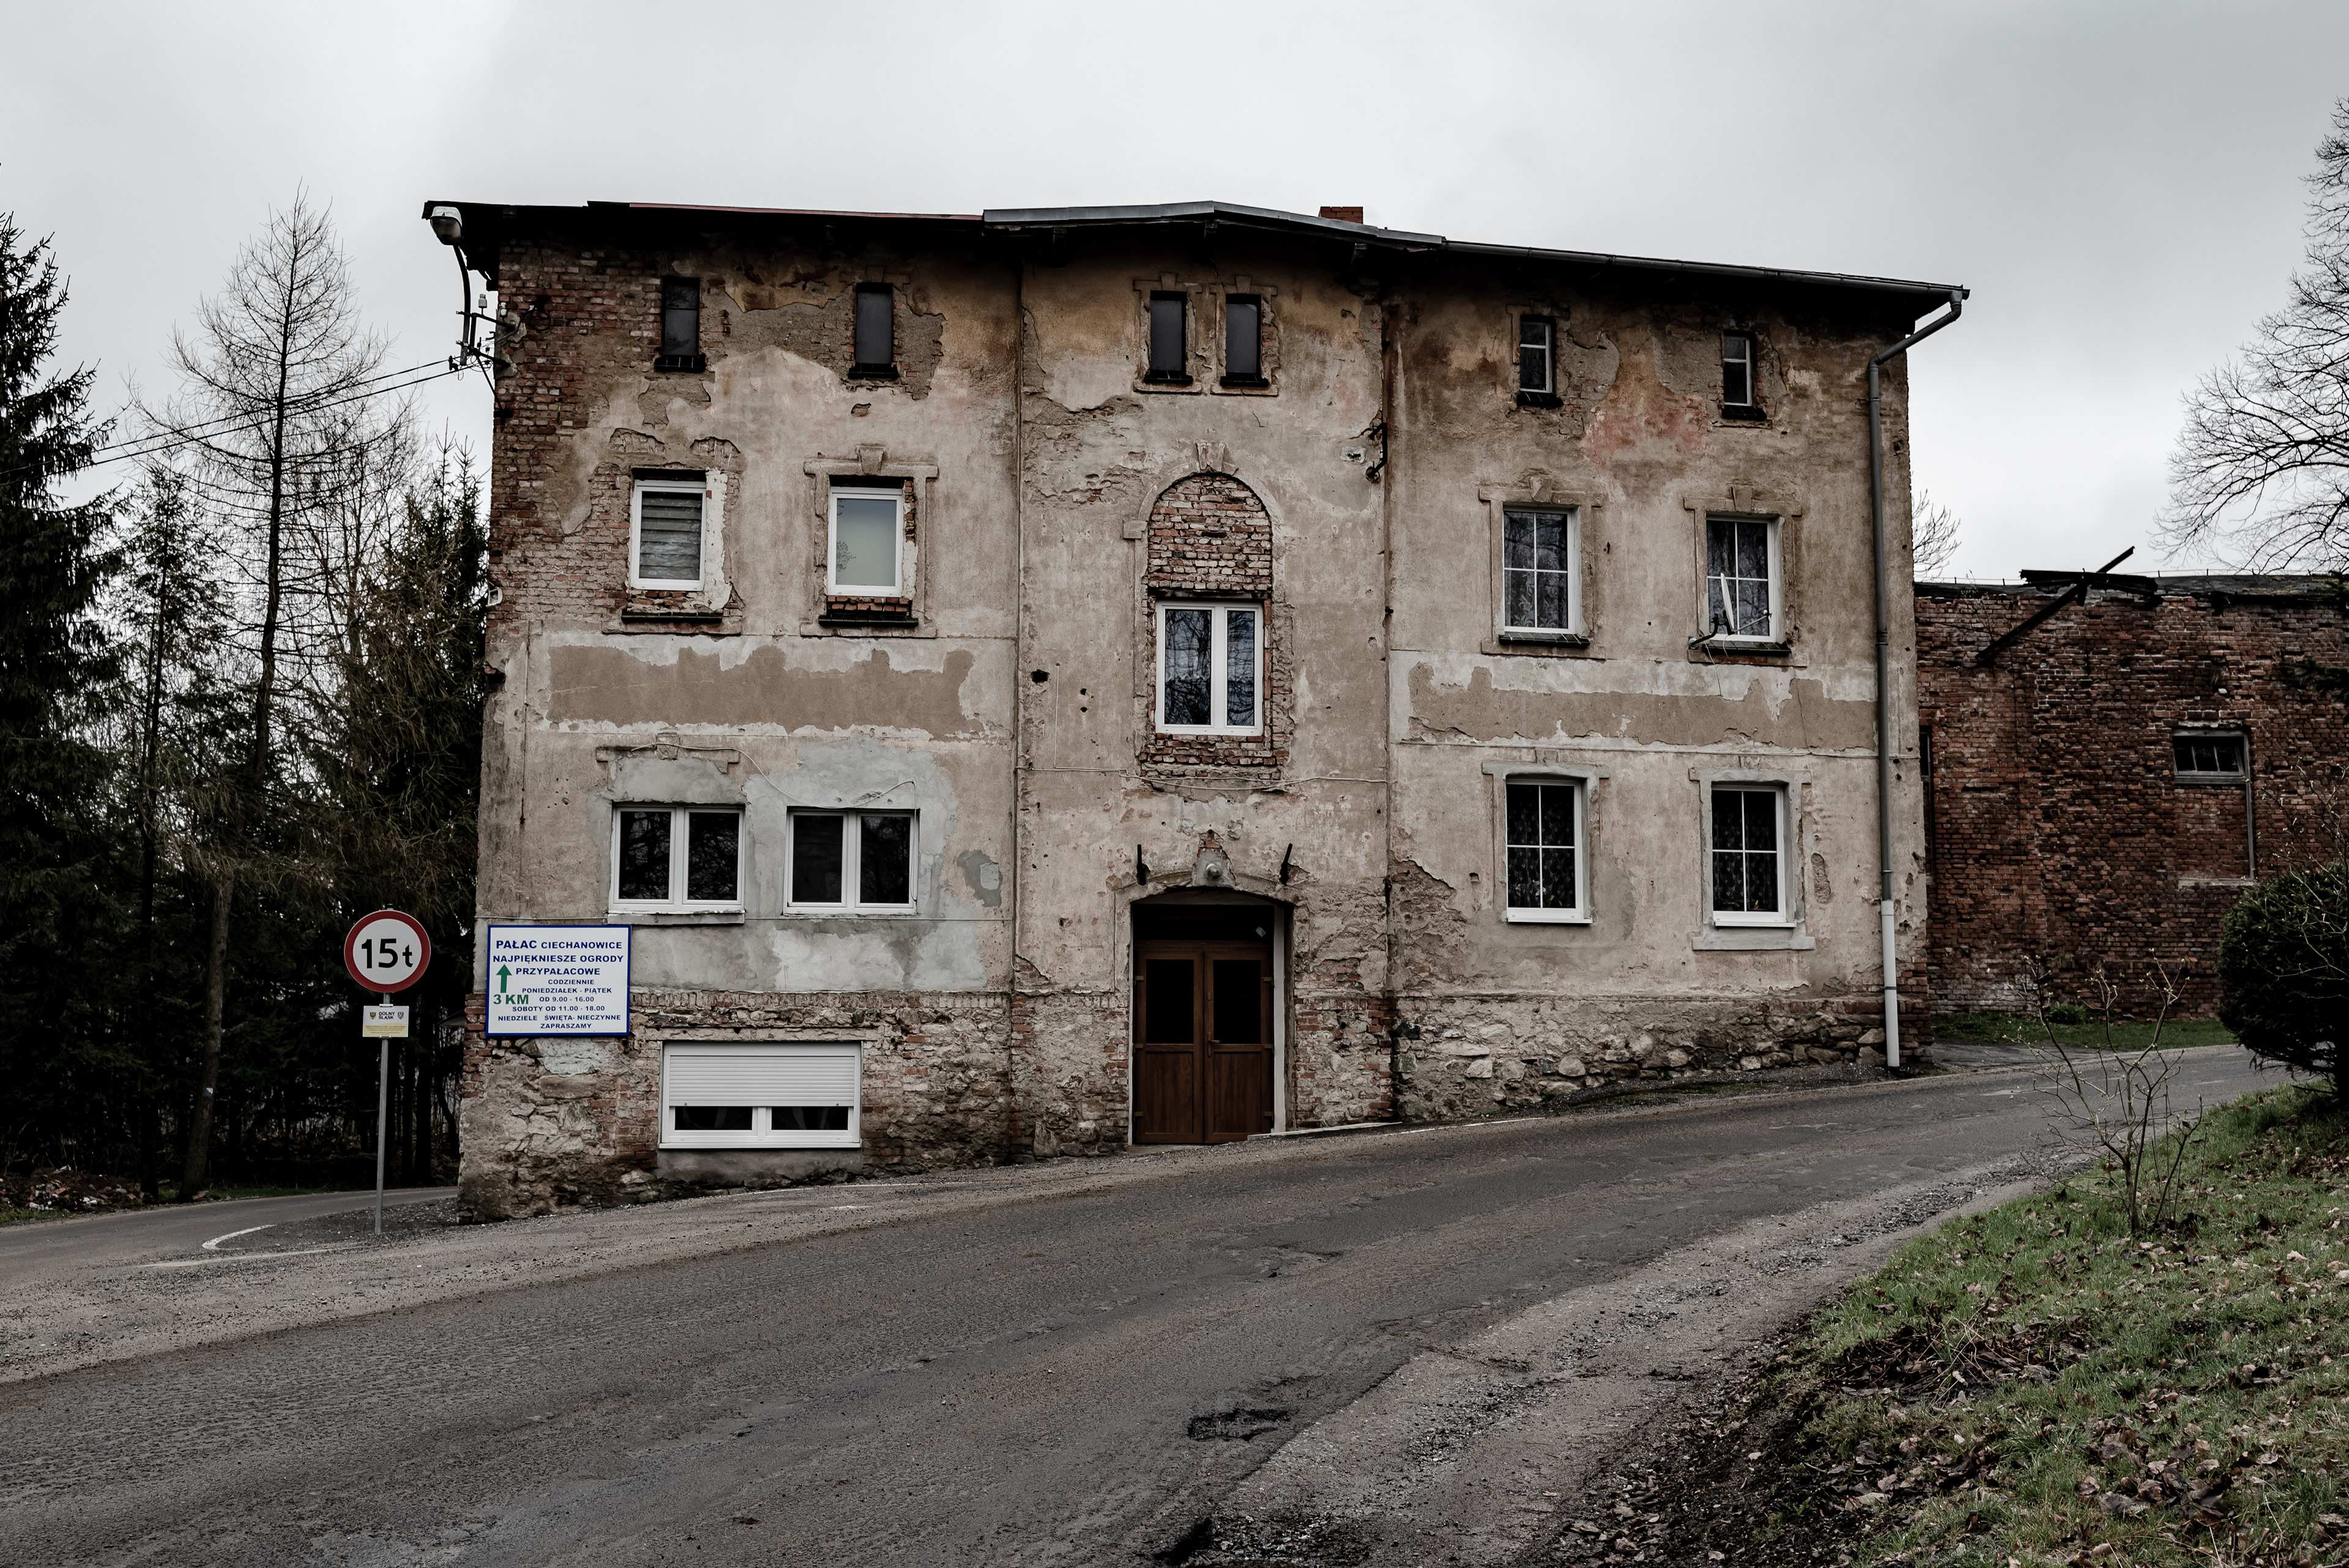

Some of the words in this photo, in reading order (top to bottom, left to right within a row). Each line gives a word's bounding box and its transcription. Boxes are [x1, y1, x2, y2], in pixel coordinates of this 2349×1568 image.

[496, 940, 537, 949] PAŁAC
[493, 955, 576, 964] NAJPIĘKNIESZE
[493, 994, 502, 1005] 3
[505, 994, 529, 1005] KM
